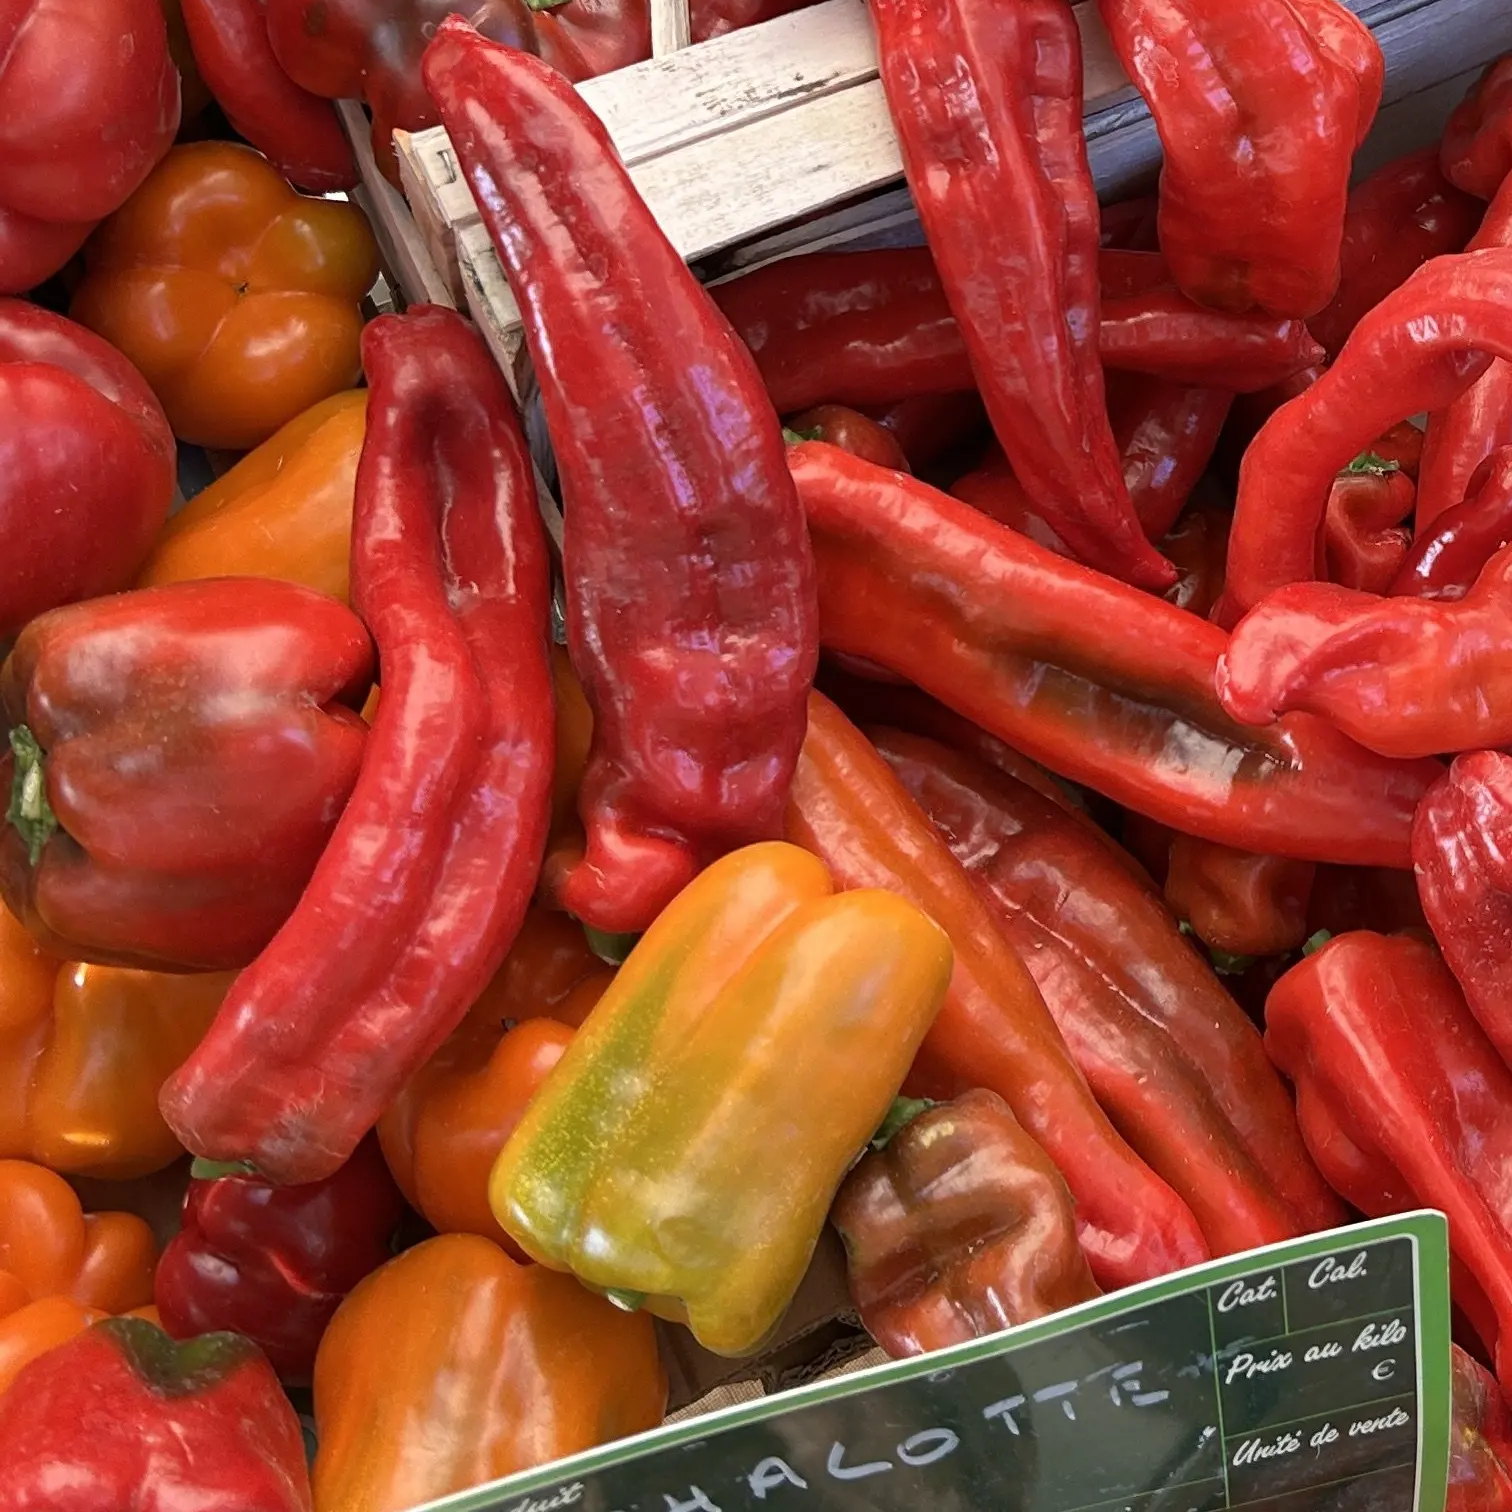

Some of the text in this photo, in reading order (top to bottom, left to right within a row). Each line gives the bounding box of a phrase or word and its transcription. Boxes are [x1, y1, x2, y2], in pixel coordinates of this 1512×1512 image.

[1217, 1275, 1278, 1313] Cat.
[1308, 1251, 1368, 1289] Cal.
[1225, 1319, 1407, 1385] Prix au kilo
[1371, 1359, 1397, 1381] €
[608, 1360, 1170, 1512] HALOTTE
[1232, 1407, 1410, 1466] Unité de vente
